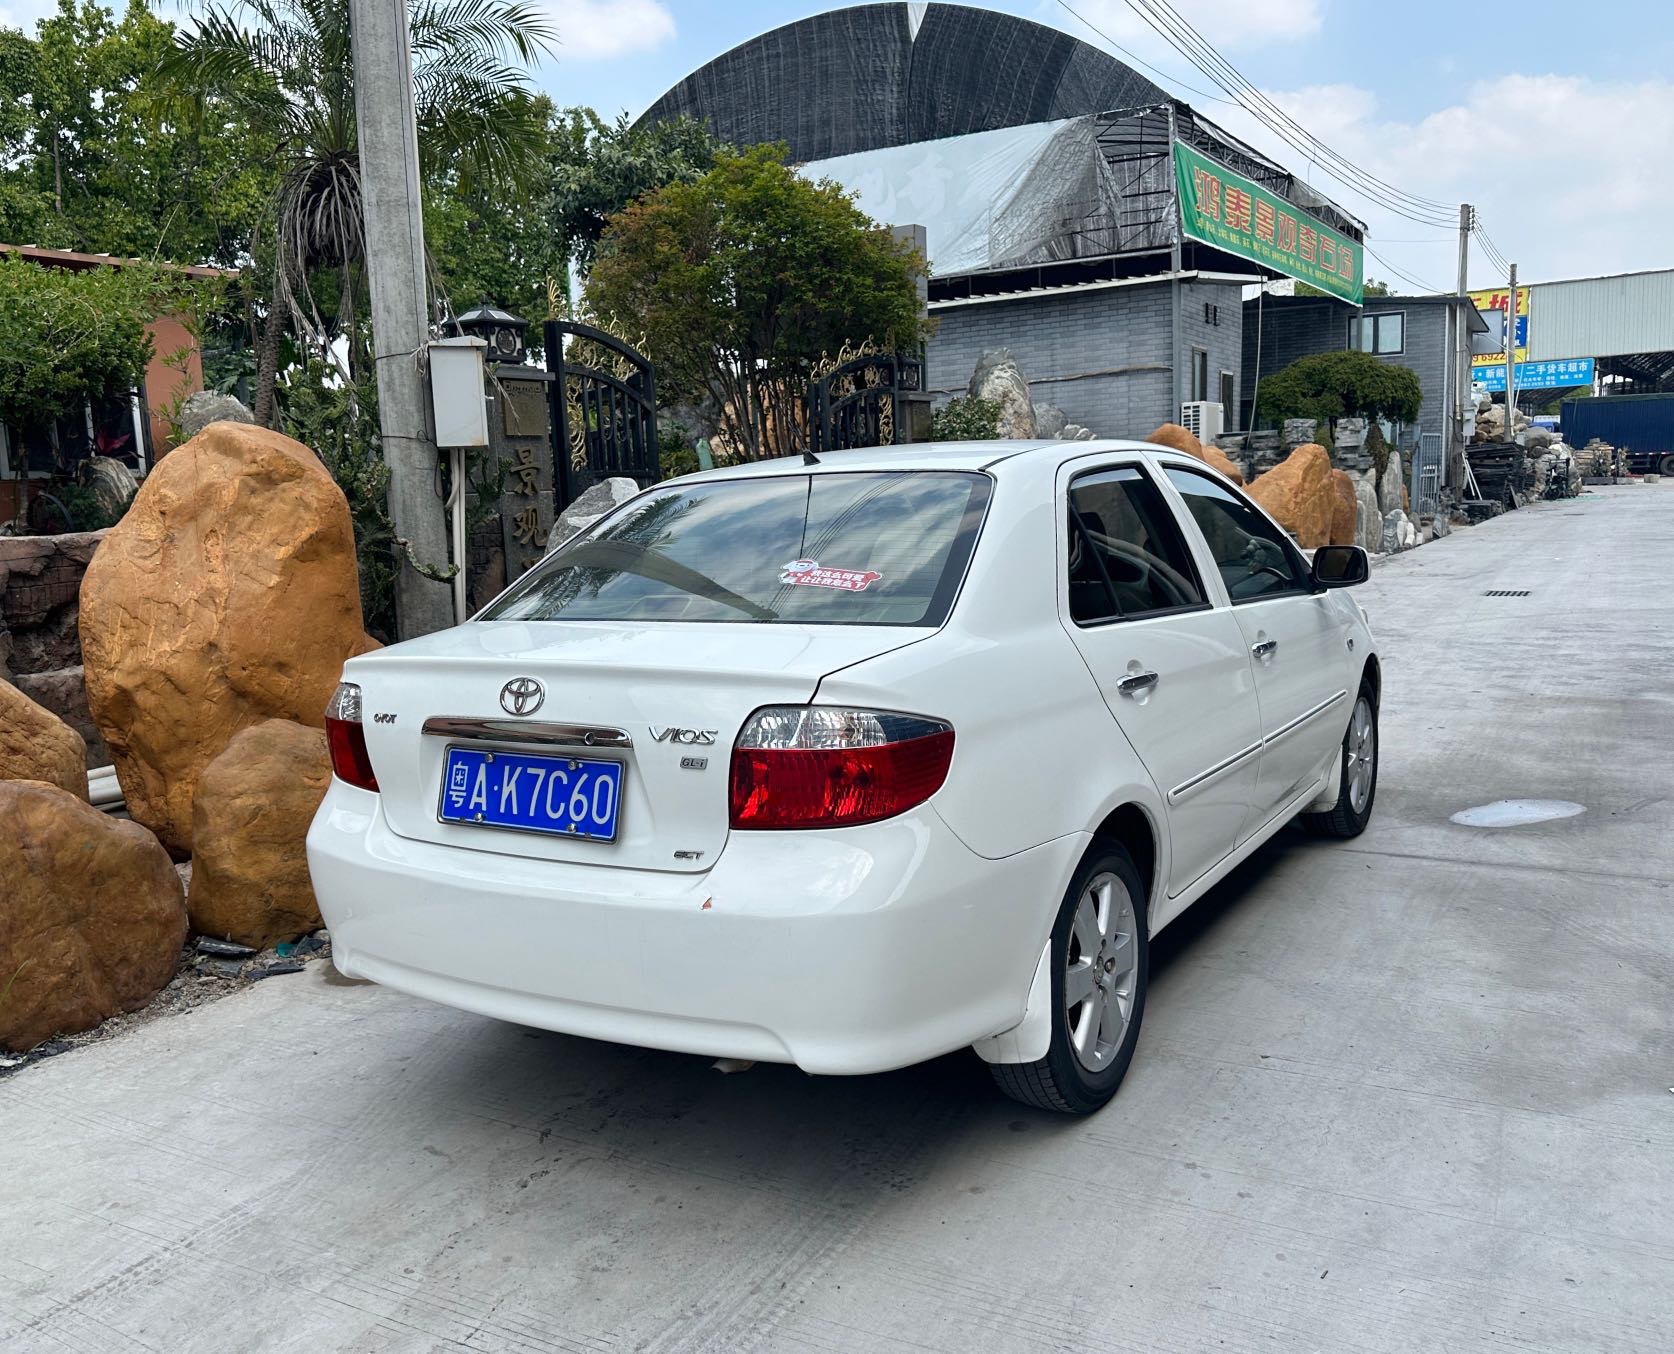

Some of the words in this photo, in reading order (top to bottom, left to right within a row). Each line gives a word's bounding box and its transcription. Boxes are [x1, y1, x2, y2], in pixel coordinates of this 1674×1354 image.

[511, 448, 548, 571] 景观
[800, 576, 866, 589] 让让我怎么了
[648, 726, 718, 745] VIOS
